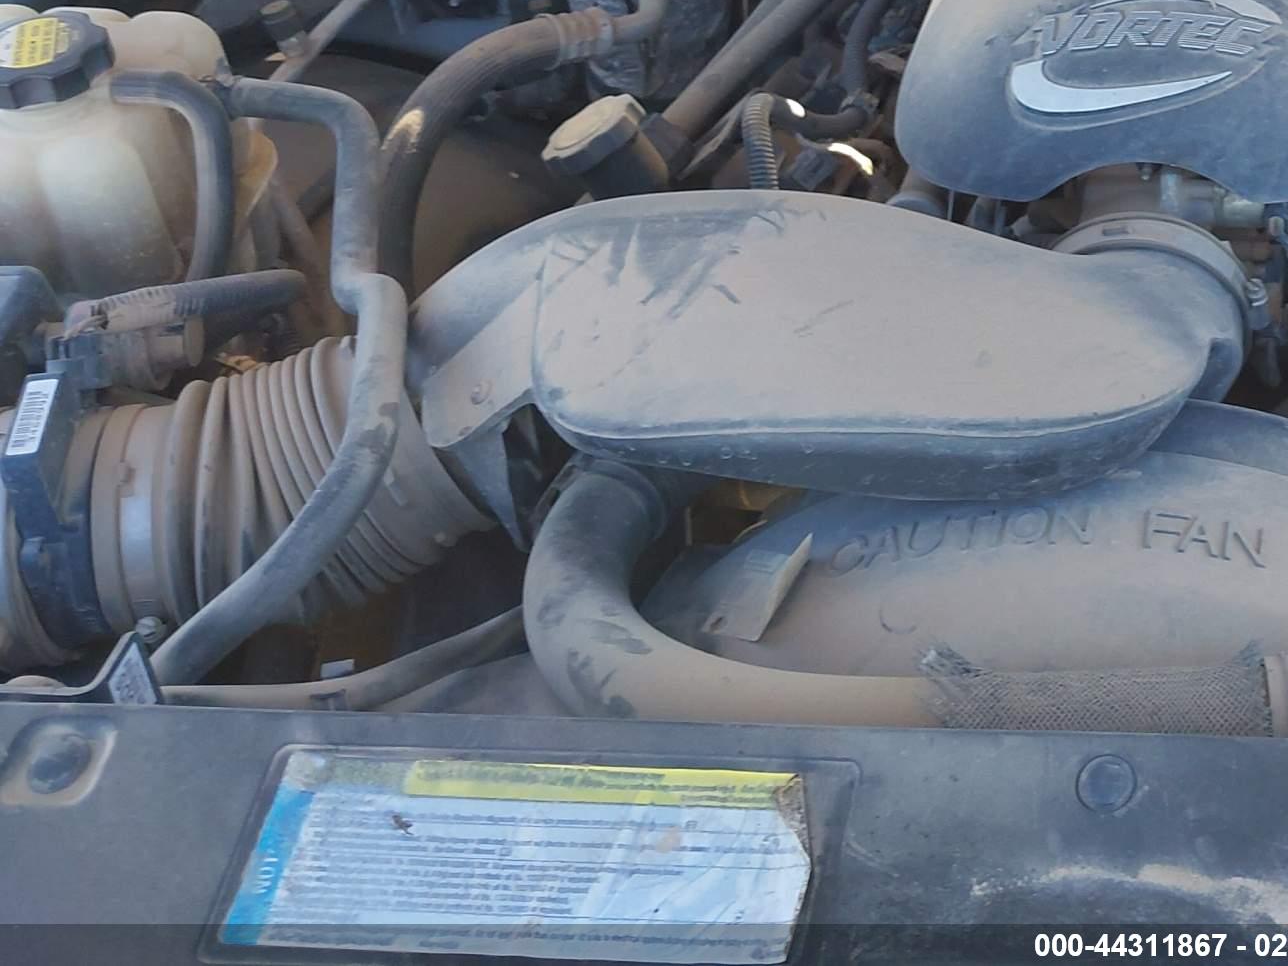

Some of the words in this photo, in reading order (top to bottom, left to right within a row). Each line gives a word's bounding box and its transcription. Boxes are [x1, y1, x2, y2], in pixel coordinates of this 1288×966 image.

[1036, 10, 1272, 56] VORTEC
[827, 505, 1097, 577] CAUTION
[1141, 508, 1266, 569] FAN
